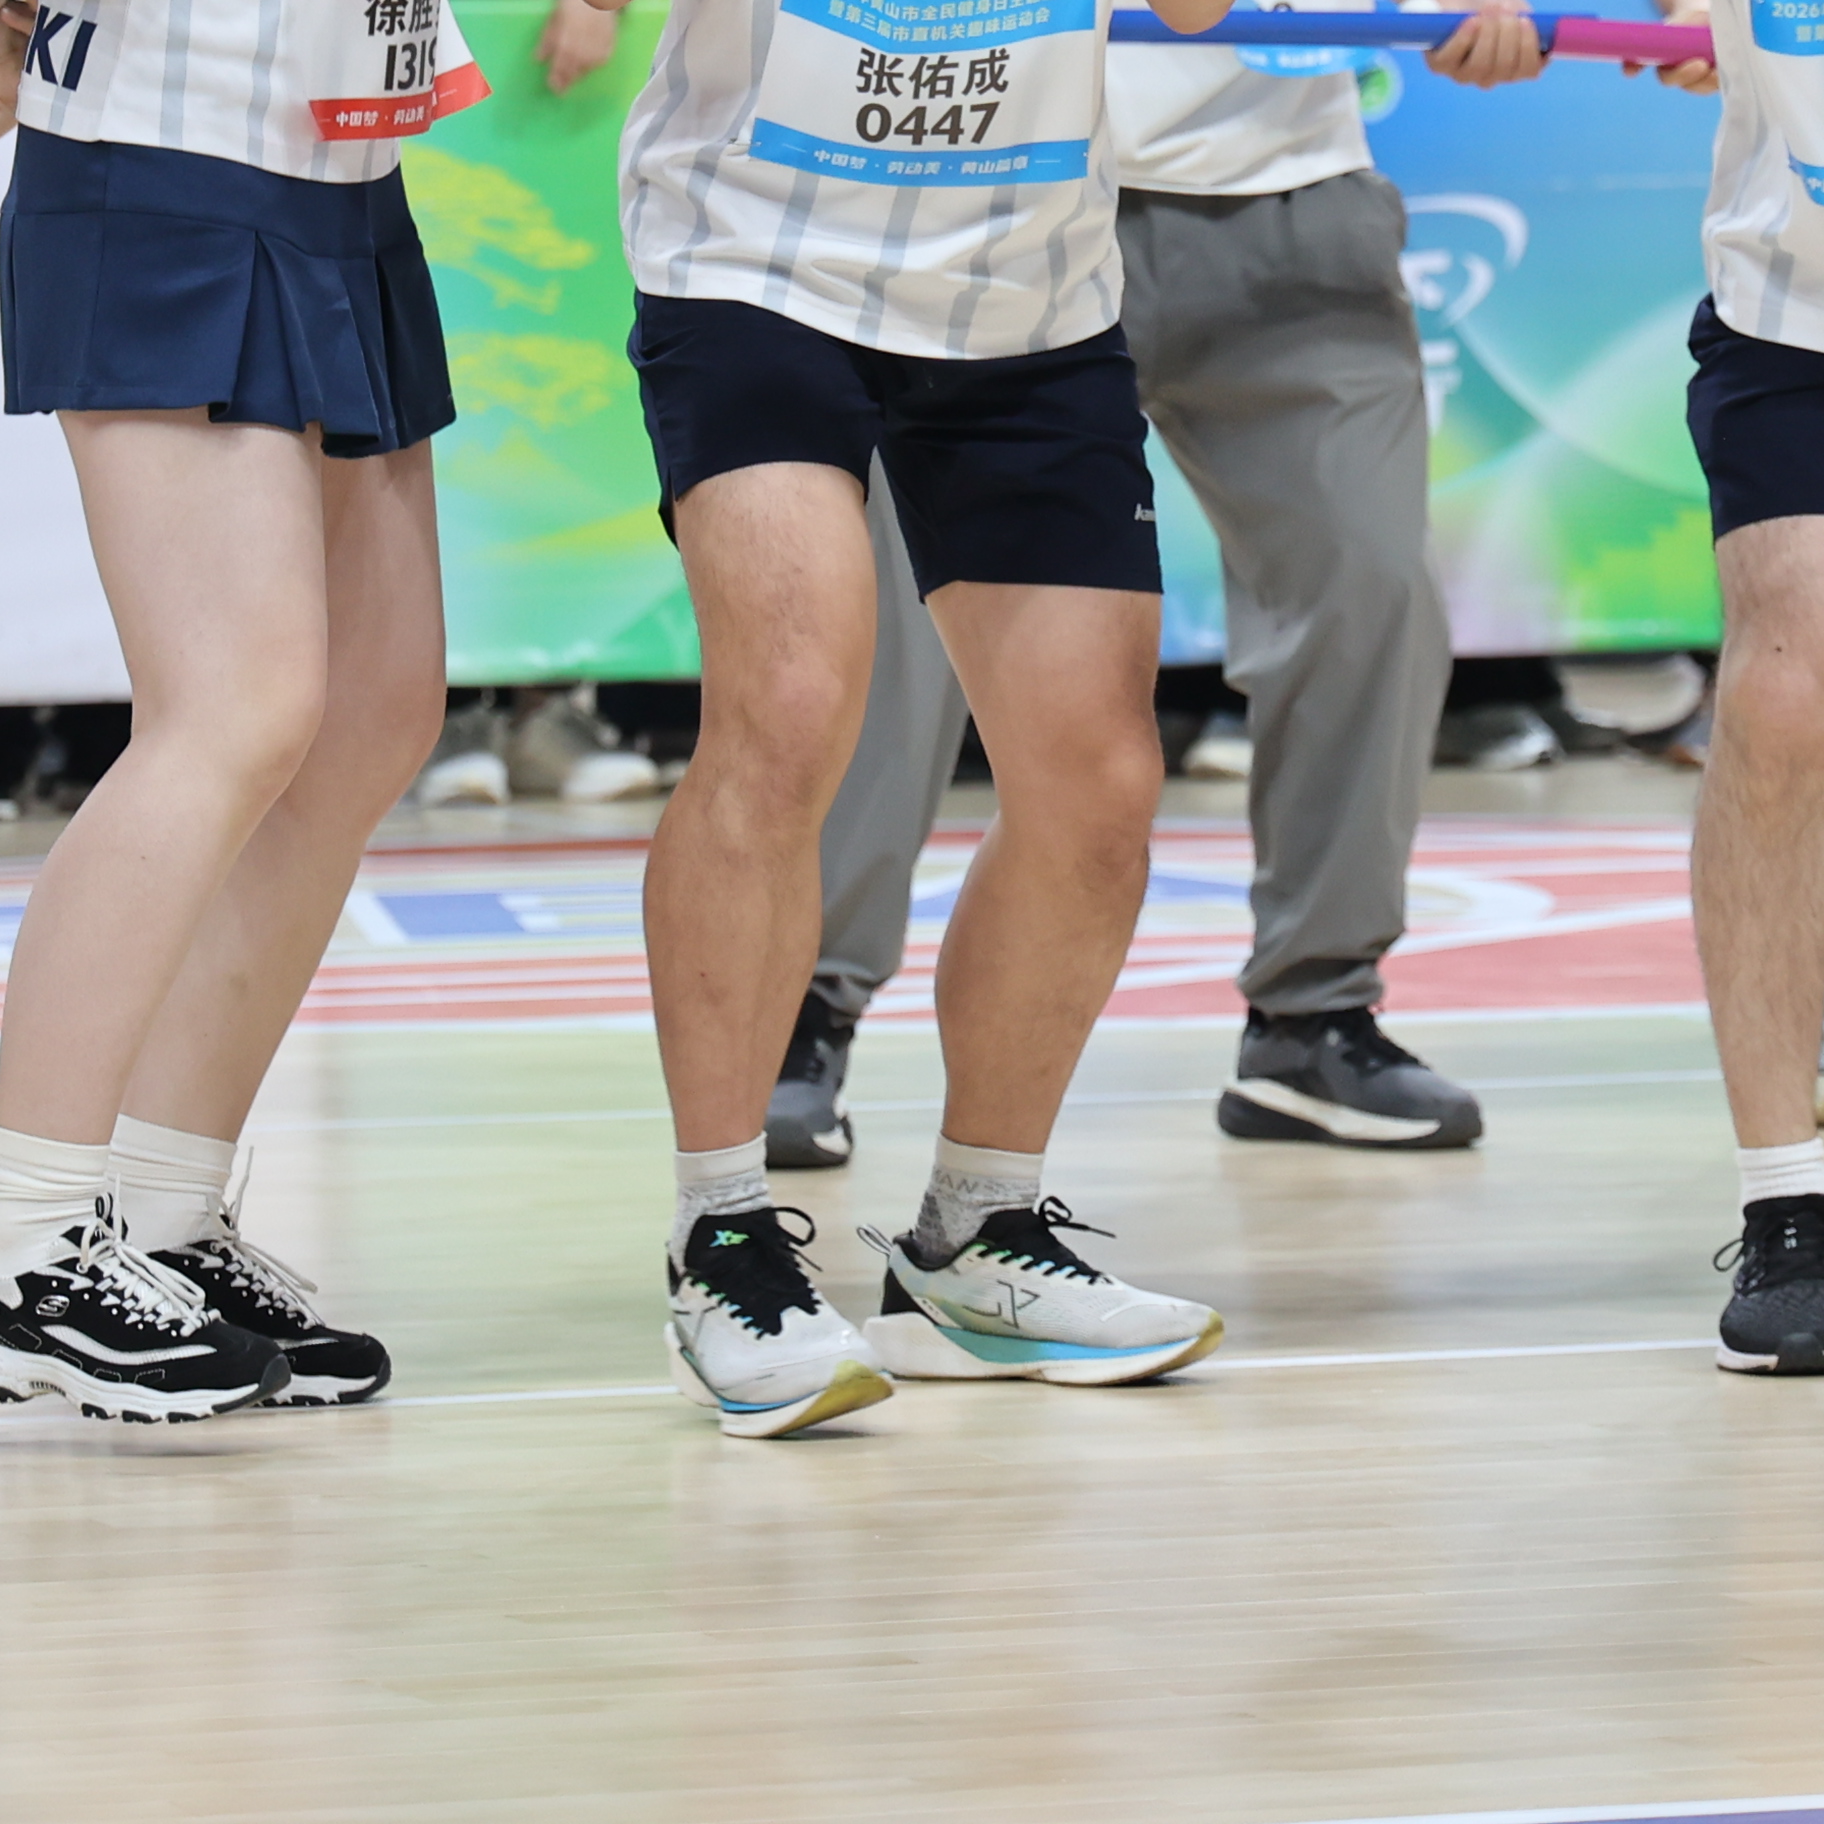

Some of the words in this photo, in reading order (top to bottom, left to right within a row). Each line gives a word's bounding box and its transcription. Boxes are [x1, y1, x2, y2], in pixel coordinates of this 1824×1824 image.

[855, 47, 1011, 100] 张佑成
[855, 101, 1001, 146] 0447
